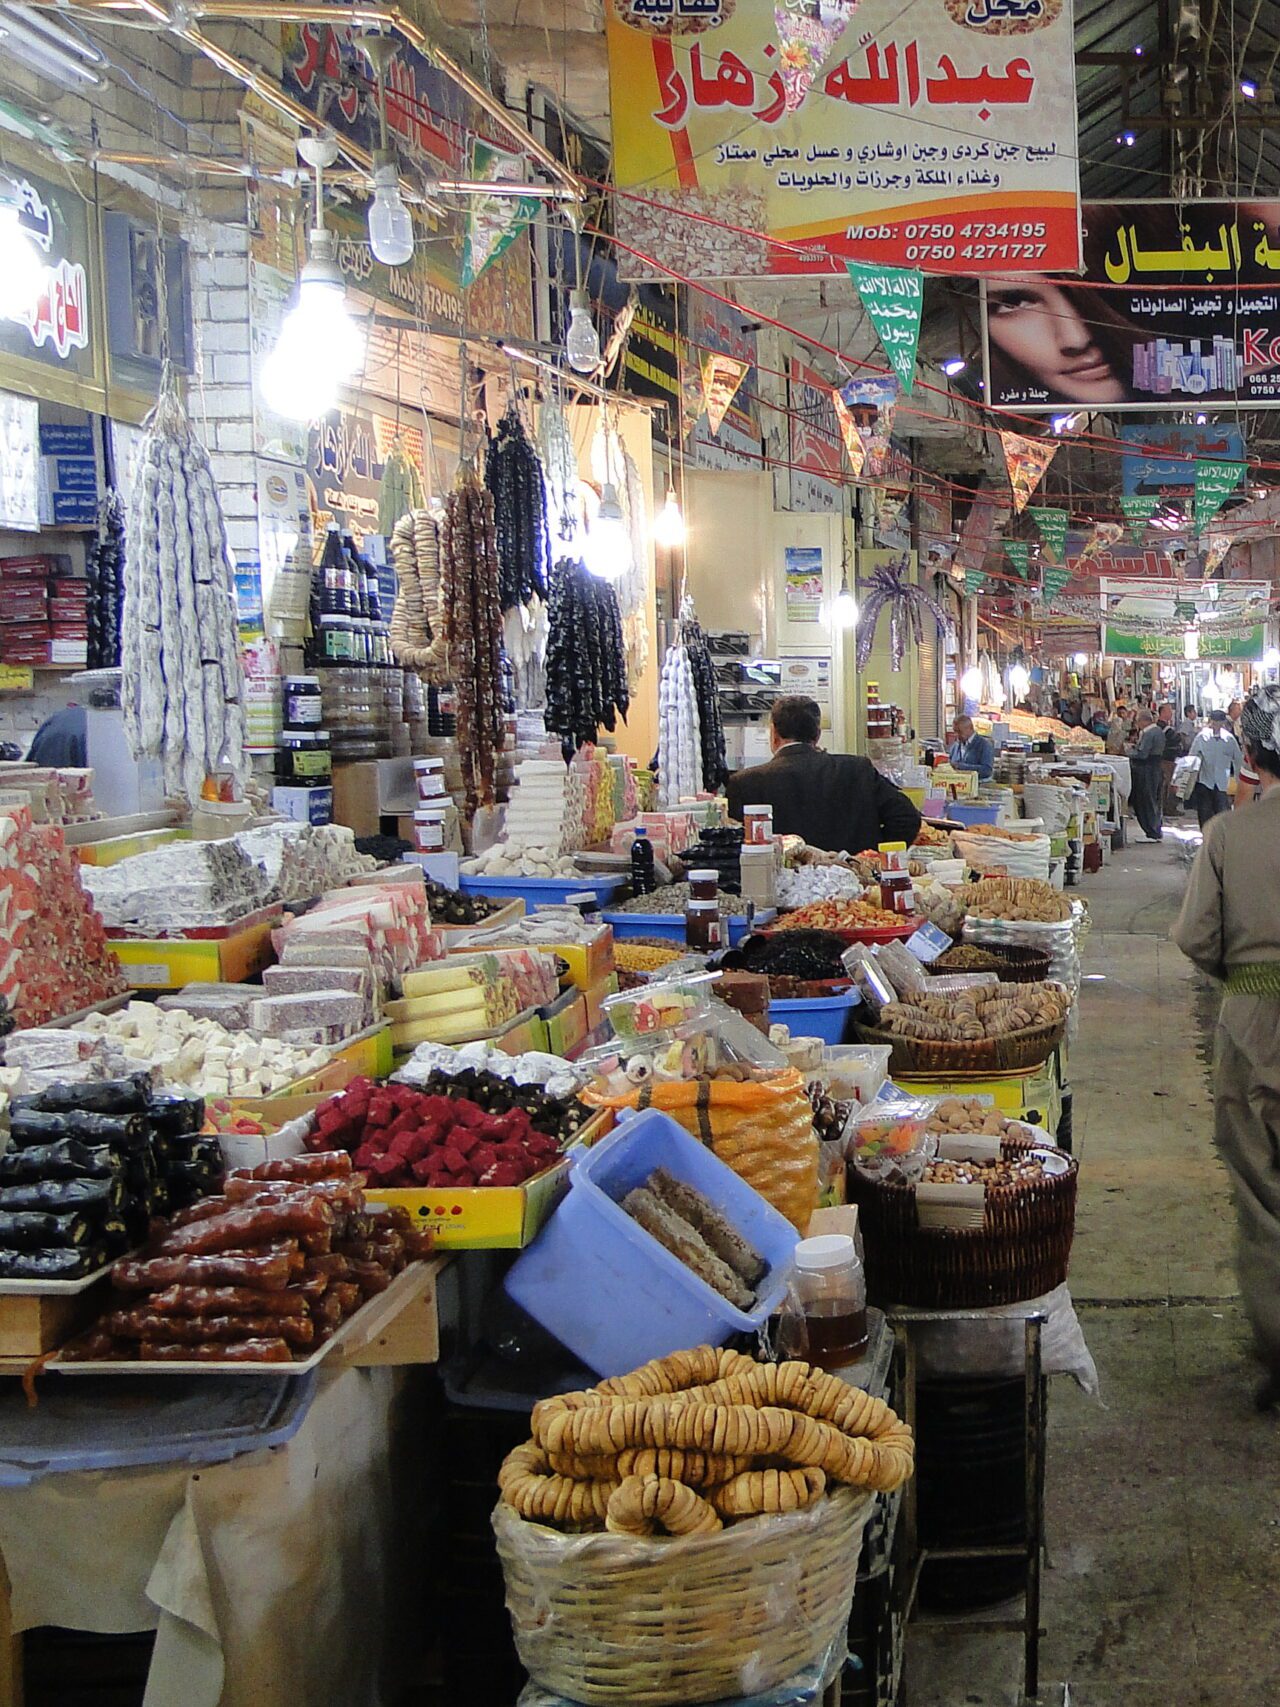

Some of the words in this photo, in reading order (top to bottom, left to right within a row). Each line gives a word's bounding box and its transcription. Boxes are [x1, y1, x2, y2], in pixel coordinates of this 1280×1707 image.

[715, 143, 757, 164] ممتاز
[806, 144, 840, 162] عسل
[846, 224, 899, 240] Mob:
[905, 224, 954, 239] 0750
[959, 223, 1046, 239] 4734195
[906, 245, 955, 260] 0750
[960, 243, 1047, 259] 4271727
[1104, 220, 1241, 285] البقال
[1029, 388, 1050, 401] جملة
[1250, 385, 1276, 395] 0750
